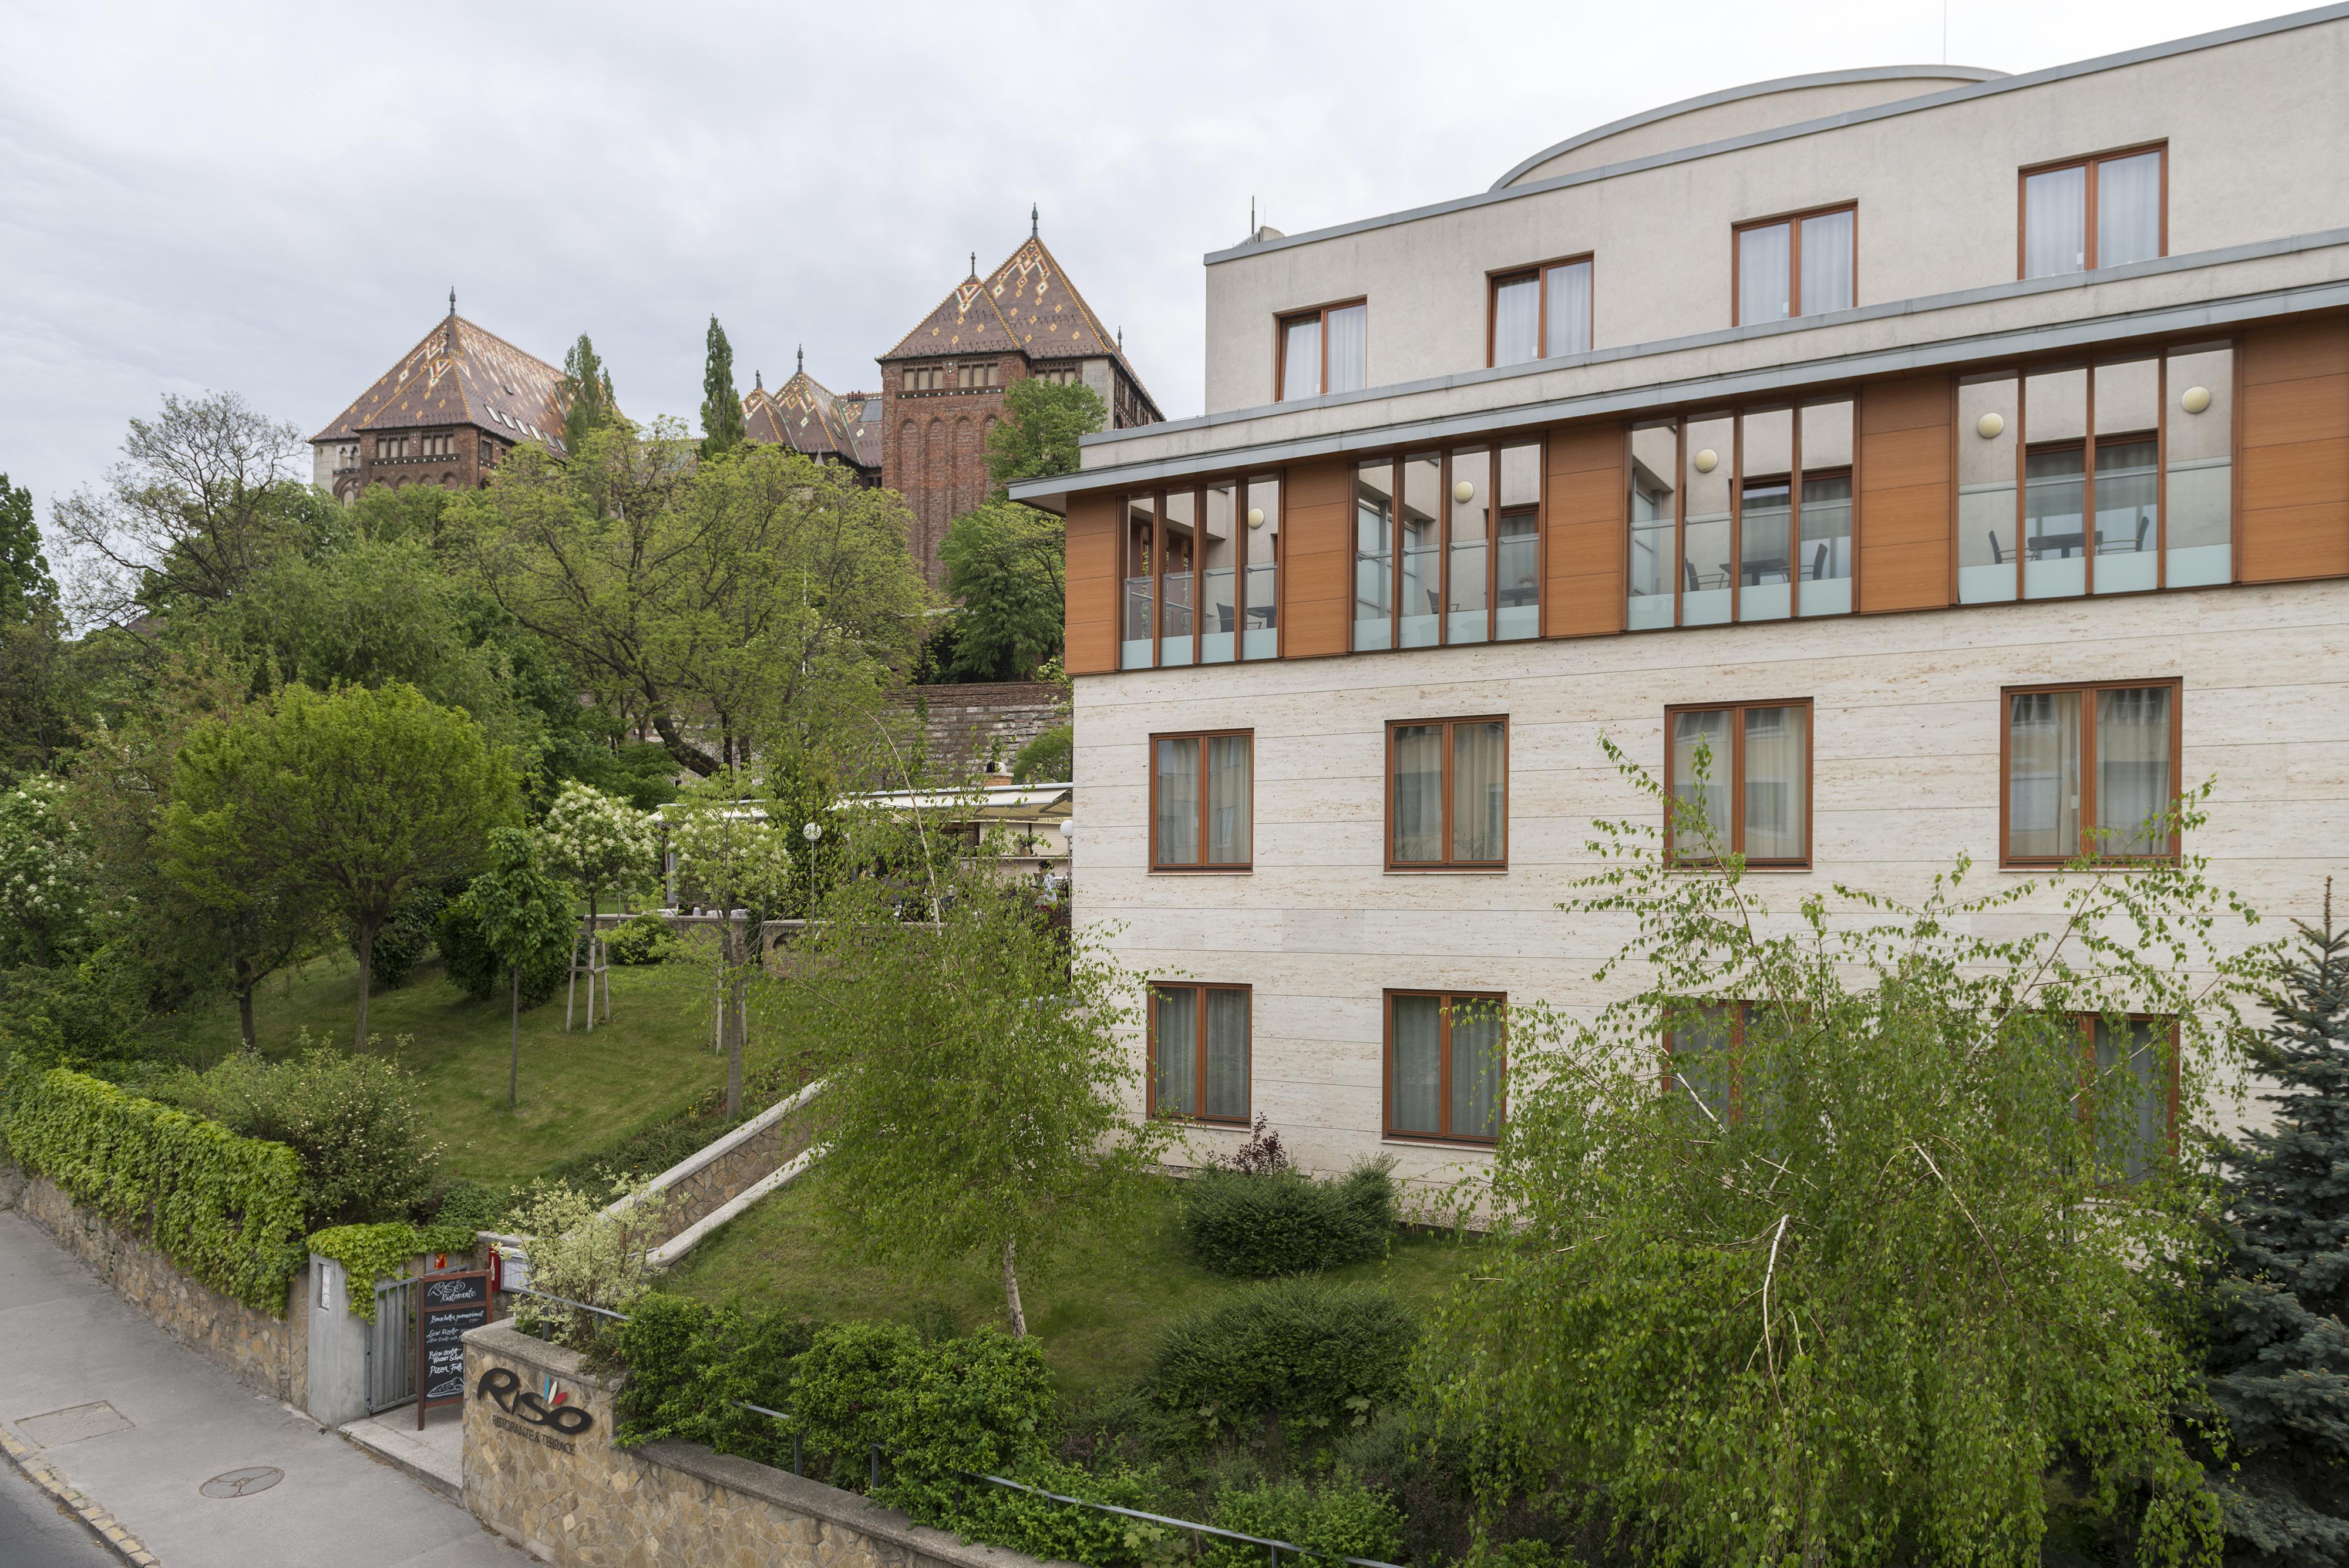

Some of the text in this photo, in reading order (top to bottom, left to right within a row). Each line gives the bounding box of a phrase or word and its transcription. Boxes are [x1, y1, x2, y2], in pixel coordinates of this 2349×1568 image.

[439, 1288, 476, 1303] Ristorante
[428, 1365, 450, 1378] Pizza
[493, 1414, 576, 1456] RISTORANTE & TERRACE
